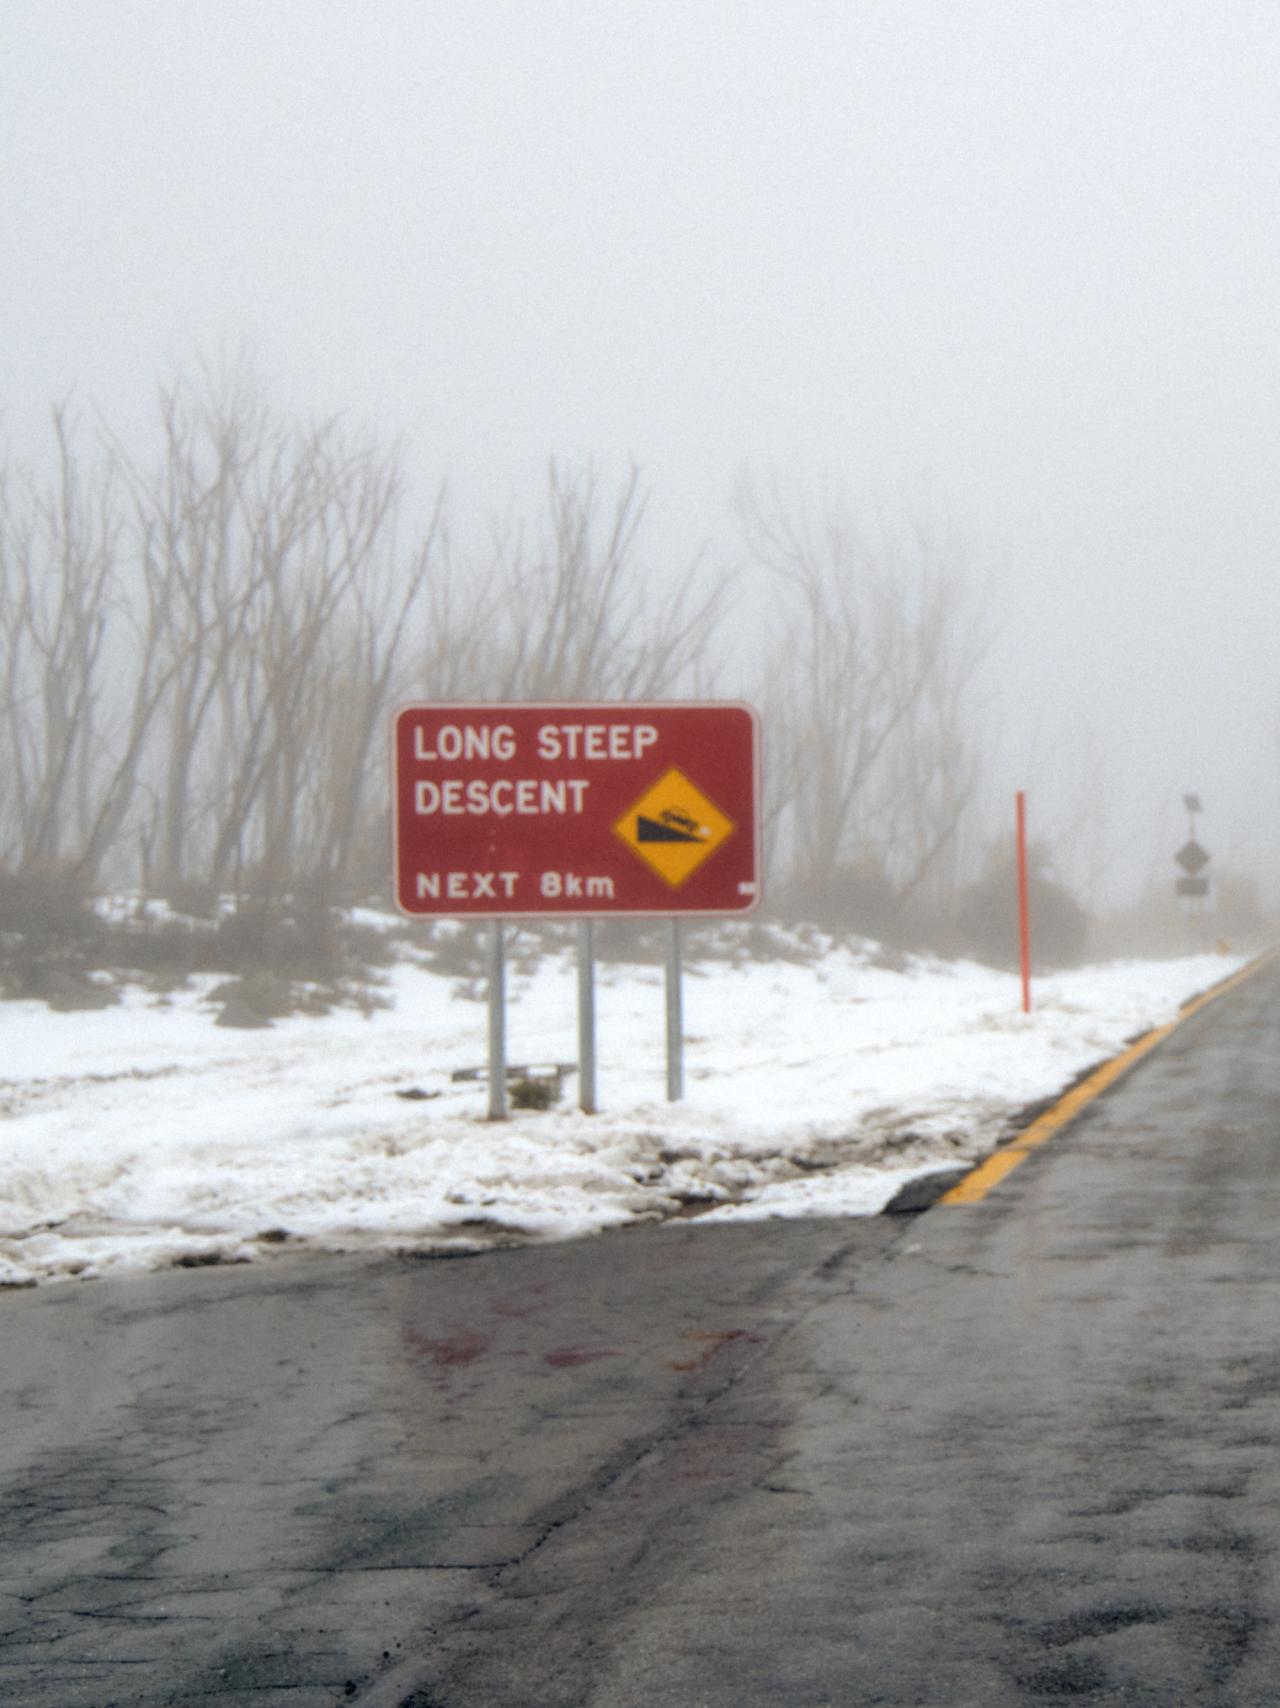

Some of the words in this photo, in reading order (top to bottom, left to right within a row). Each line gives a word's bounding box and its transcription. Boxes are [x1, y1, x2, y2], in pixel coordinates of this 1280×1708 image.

[414, 725, 517, 760] LONG
[537, 725, 659, 760] STEEP
[414, 780, 590, 815] DESCENT
[416, 873, 519, 898] NEXT
[540, 872, 615, 898] 8km
